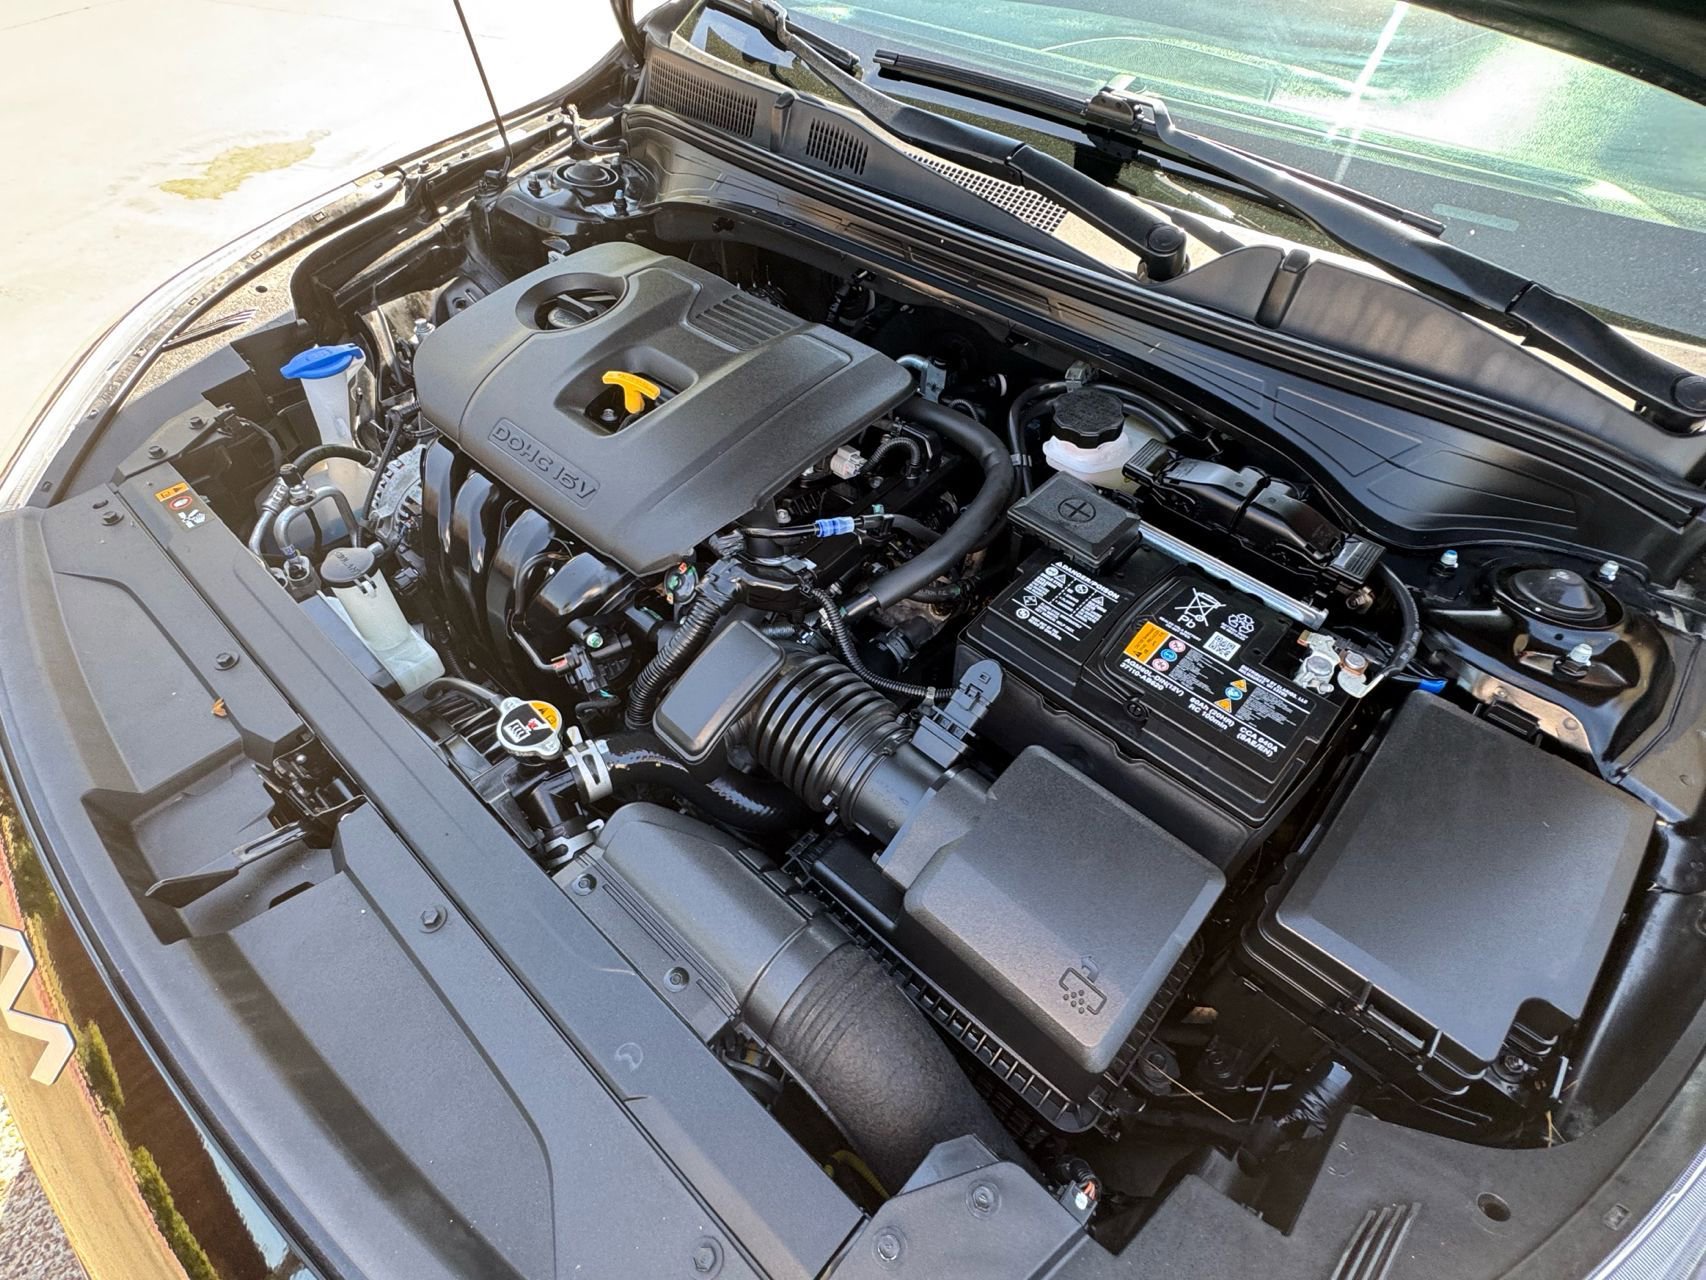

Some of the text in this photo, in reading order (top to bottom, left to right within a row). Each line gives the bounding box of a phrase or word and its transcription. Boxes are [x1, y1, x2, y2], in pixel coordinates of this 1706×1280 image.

[492, 427, 597, 499] DOHC 16V
[1061, 563, 1120, 600] DANGER/POISON
[1177, 614, 1197, 629] Pb
[1239, 727, 1257, 741] CCA
